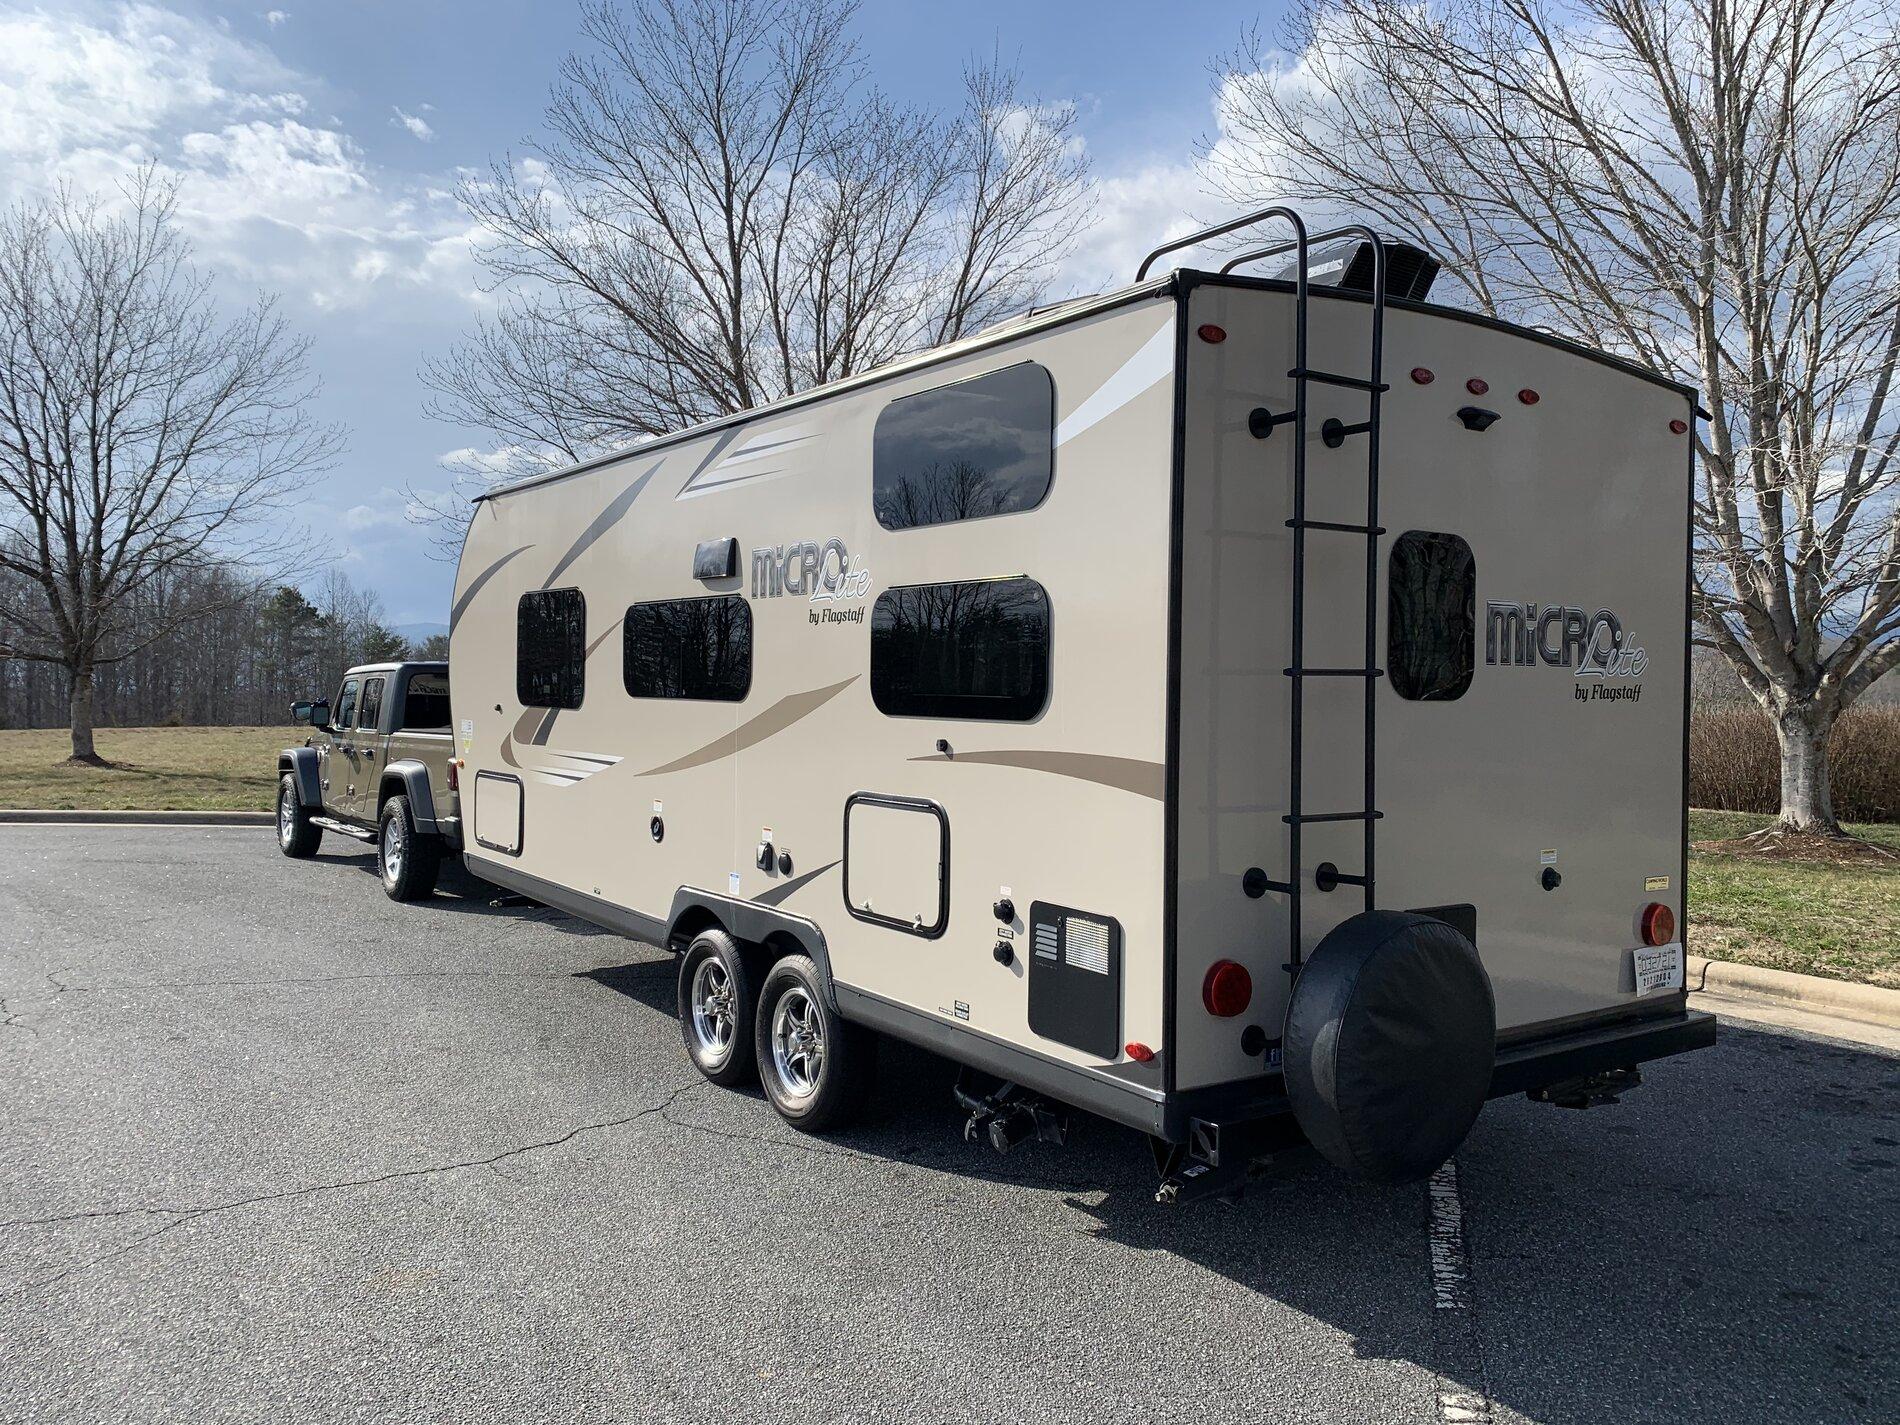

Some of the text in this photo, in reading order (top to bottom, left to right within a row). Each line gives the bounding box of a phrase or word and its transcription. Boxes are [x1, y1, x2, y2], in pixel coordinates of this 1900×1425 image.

[809, 548, 873, 602] Lite
[808, 606, 865, 625] by Flagstaff
[1574, 620, 1649, 679] Lite
[1575, 684, 1642, 702] by Flagstaff
